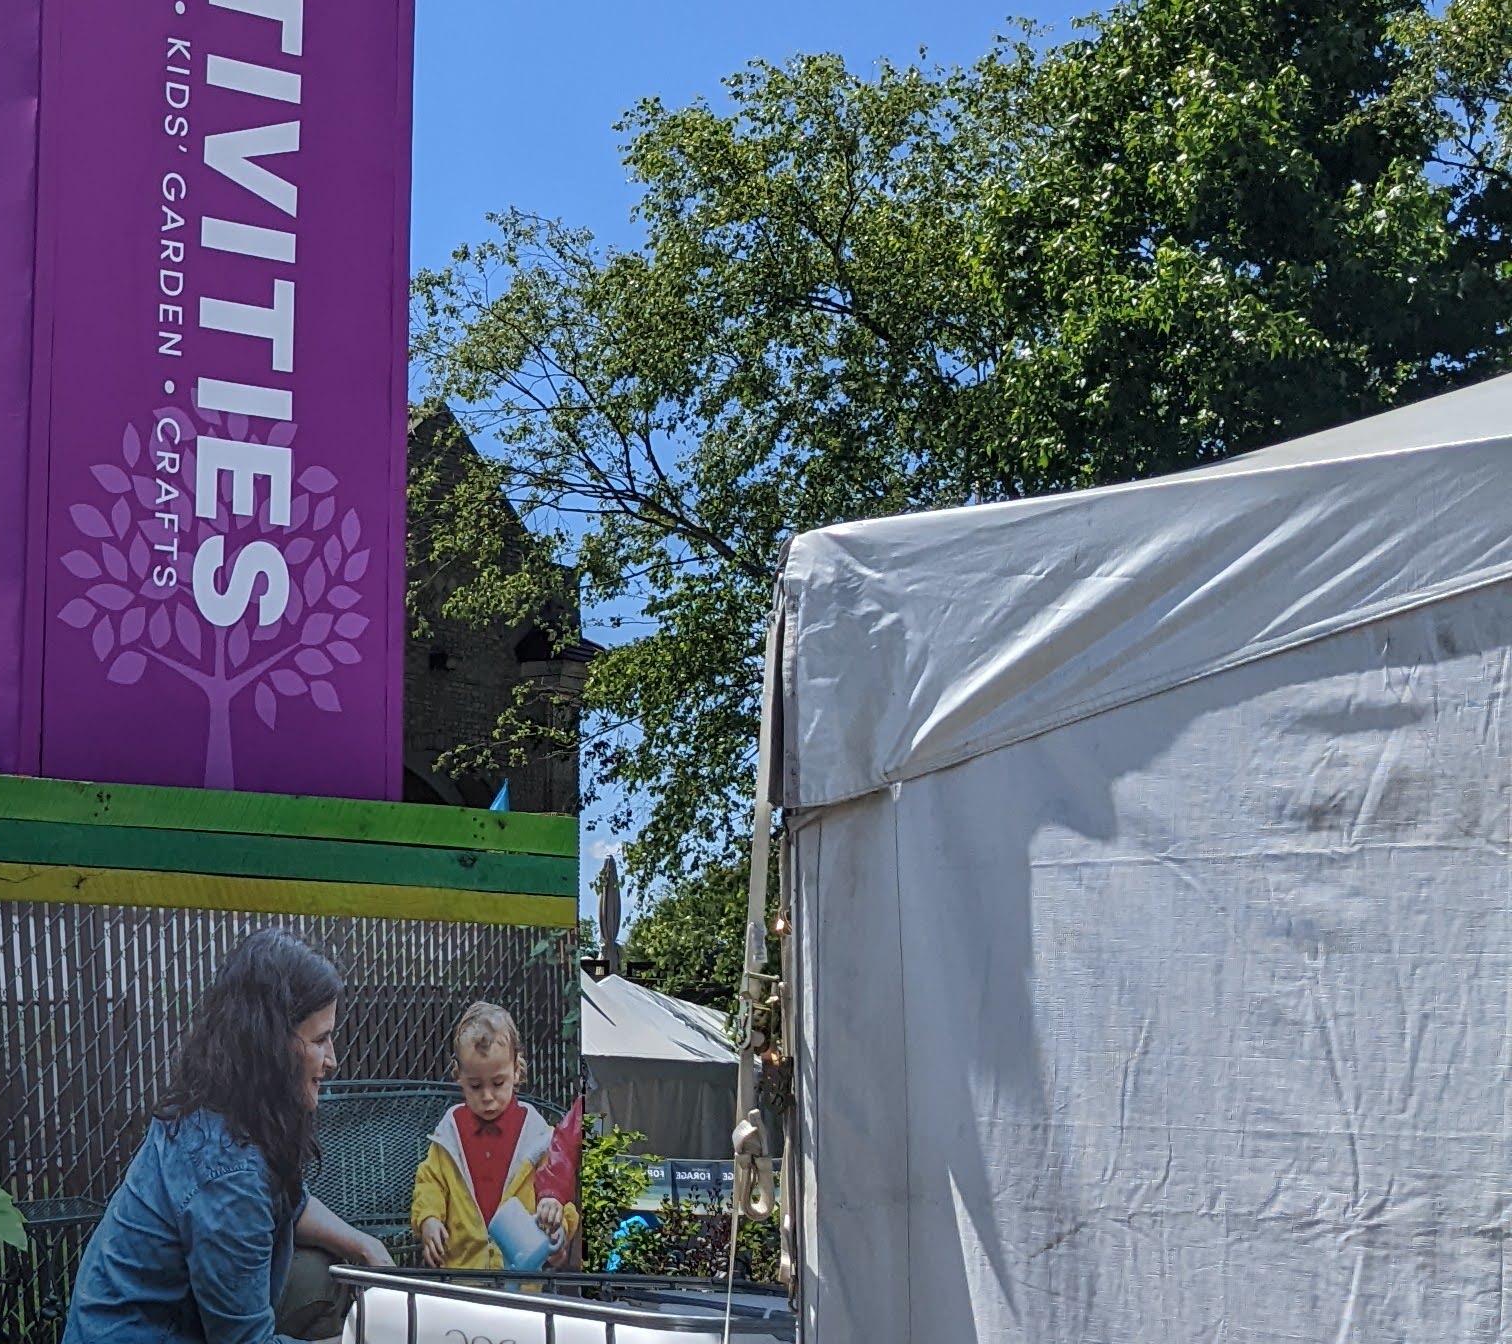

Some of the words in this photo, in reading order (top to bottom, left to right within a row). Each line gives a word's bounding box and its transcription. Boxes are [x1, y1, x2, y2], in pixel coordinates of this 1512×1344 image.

[164, 36, 191, 153] KIDS'
[158, 171, 187, 358] GARDEN
[152, 417, 181, 588] CRAFTS
